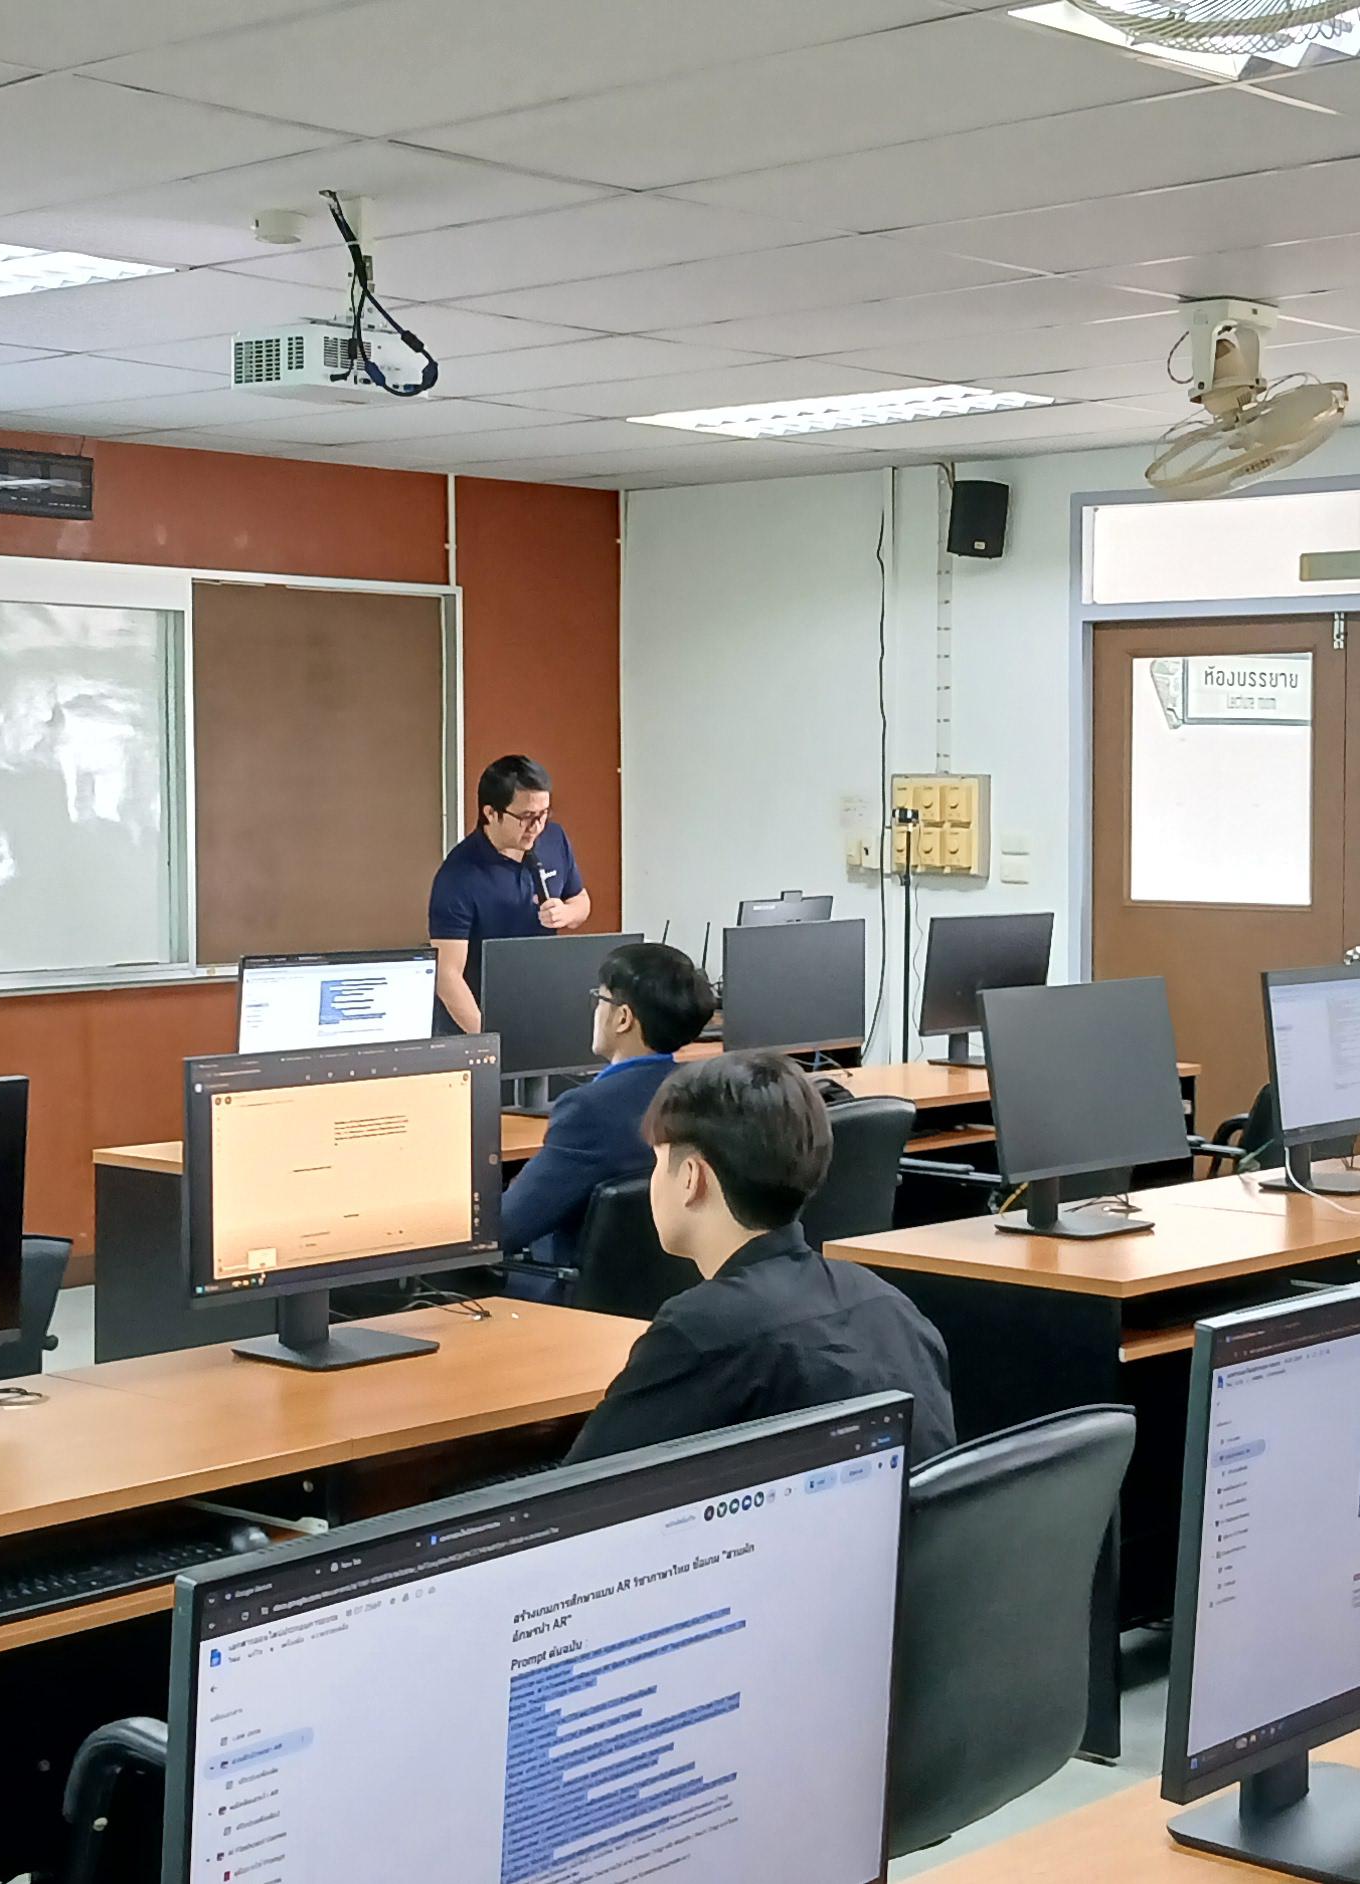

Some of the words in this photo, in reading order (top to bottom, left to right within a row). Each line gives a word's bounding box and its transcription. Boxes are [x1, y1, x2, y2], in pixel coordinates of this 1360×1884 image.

[1204, 665, 1299, 689] ห้องบรรยาย
[616, 1579, 631, 1593] AR
[510, 1650, 547, 1671] Prompt
